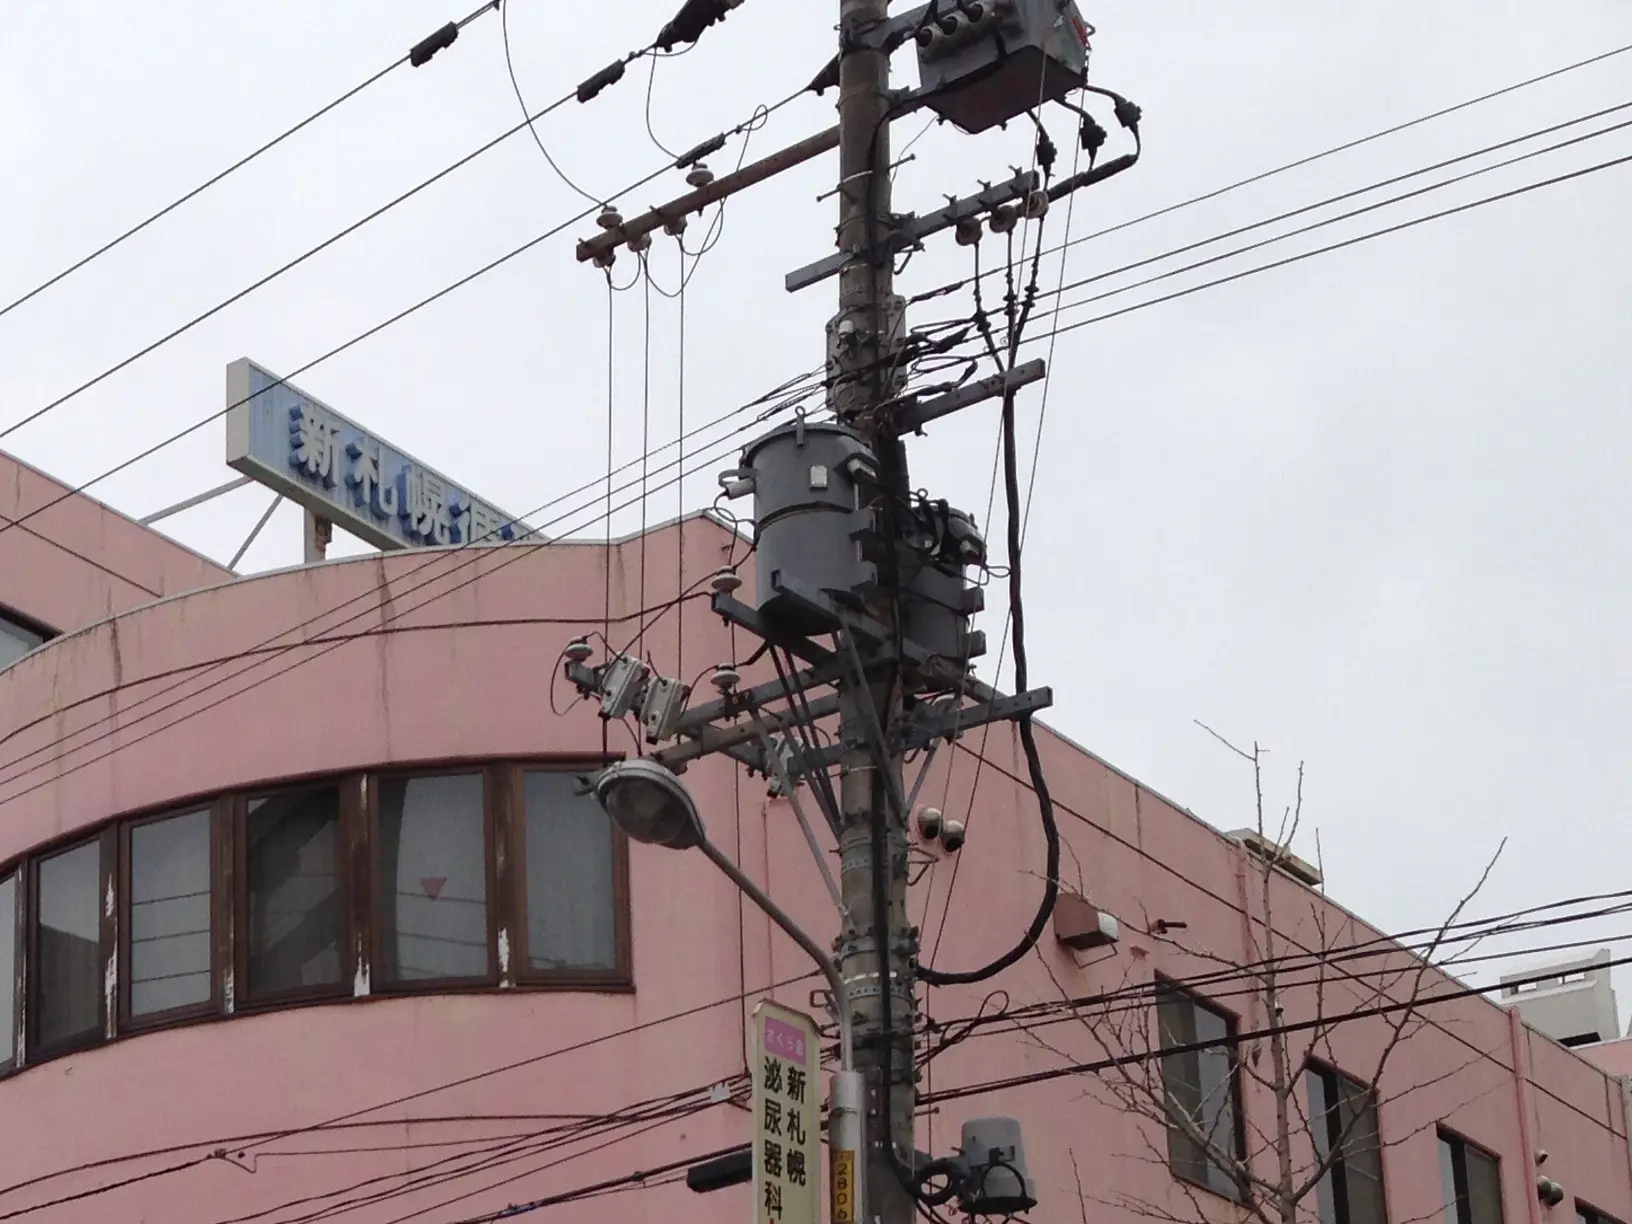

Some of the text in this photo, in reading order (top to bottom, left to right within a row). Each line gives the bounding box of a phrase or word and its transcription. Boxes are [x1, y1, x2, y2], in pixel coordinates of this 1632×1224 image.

[763, 1055, 784, 1221] 泌尿器科
[786, 1066, 807, 1188] 新札幌
